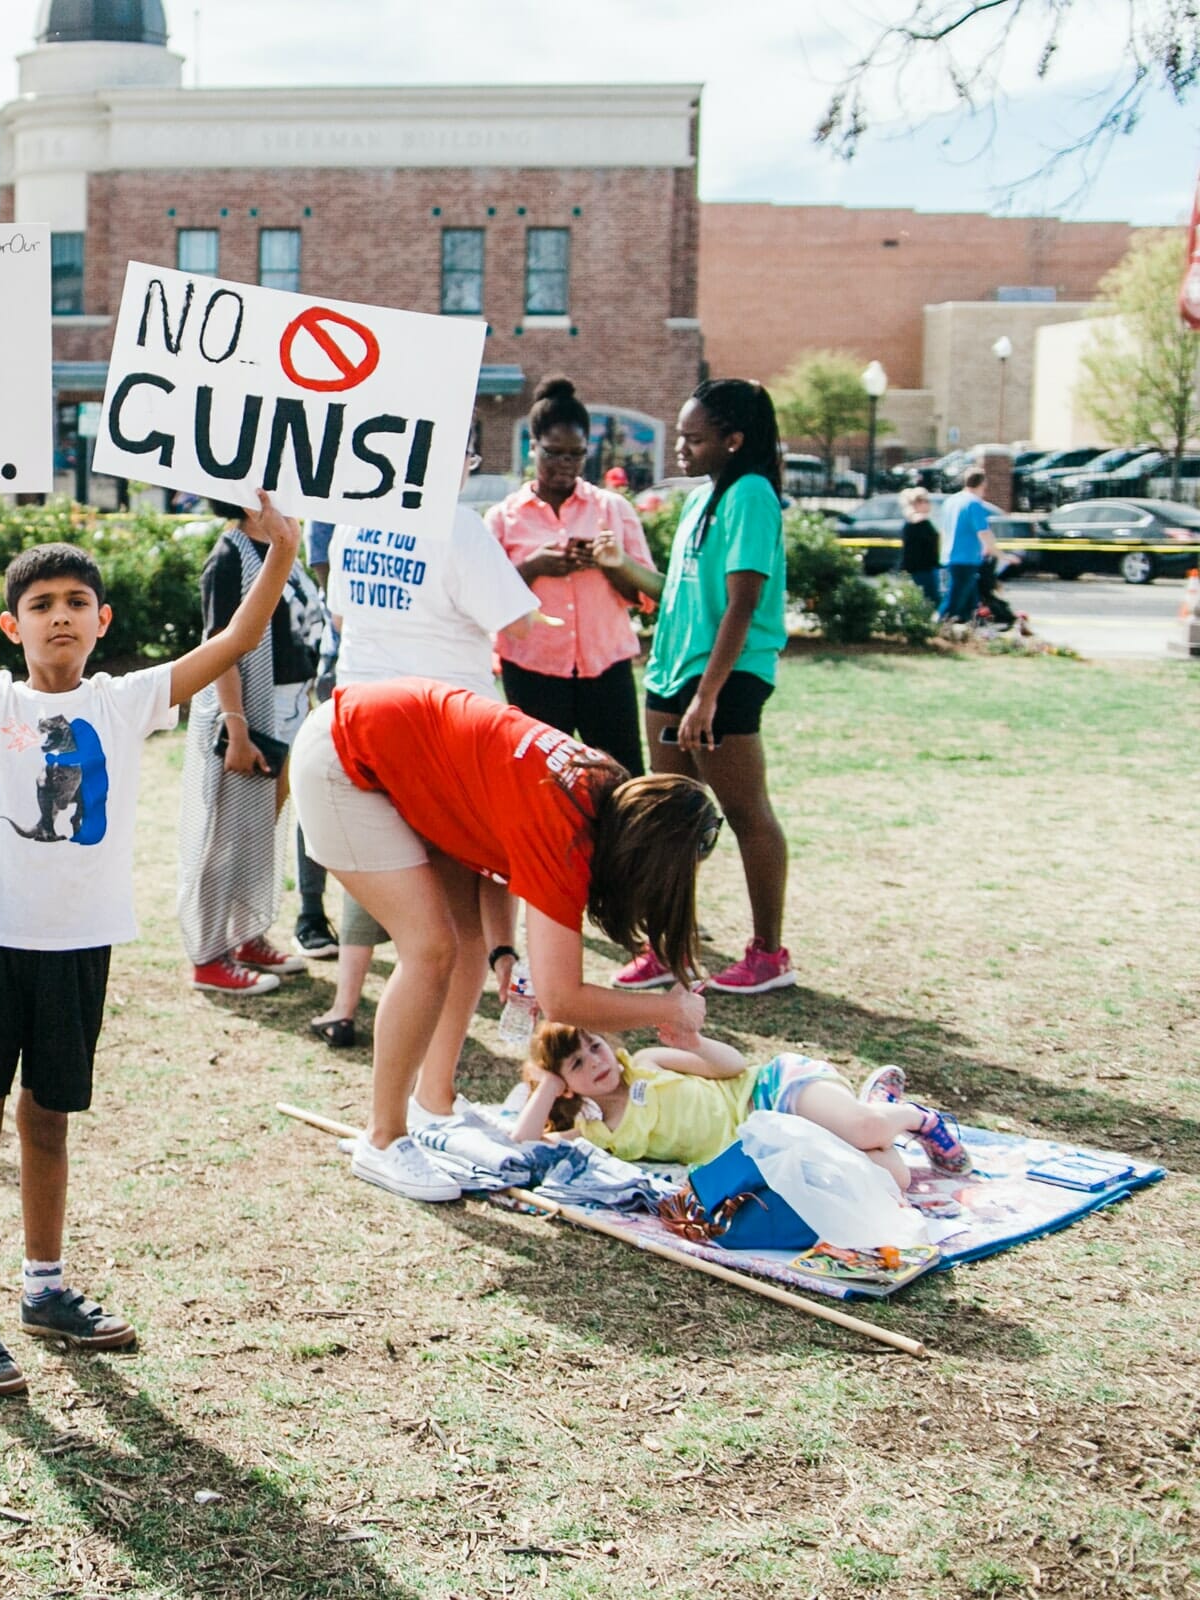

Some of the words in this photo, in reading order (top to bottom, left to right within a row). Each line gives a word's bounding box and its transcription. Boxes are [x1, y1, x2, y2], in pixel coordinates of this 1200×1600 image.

[108, 372, 435, 509] GUNS!
[357, 528, 382, 545] ARE
[387, 532, 416, 552] YOU
[342, 547, 427, 585] REGISTERED
[350, 580, 365, 605] TO
